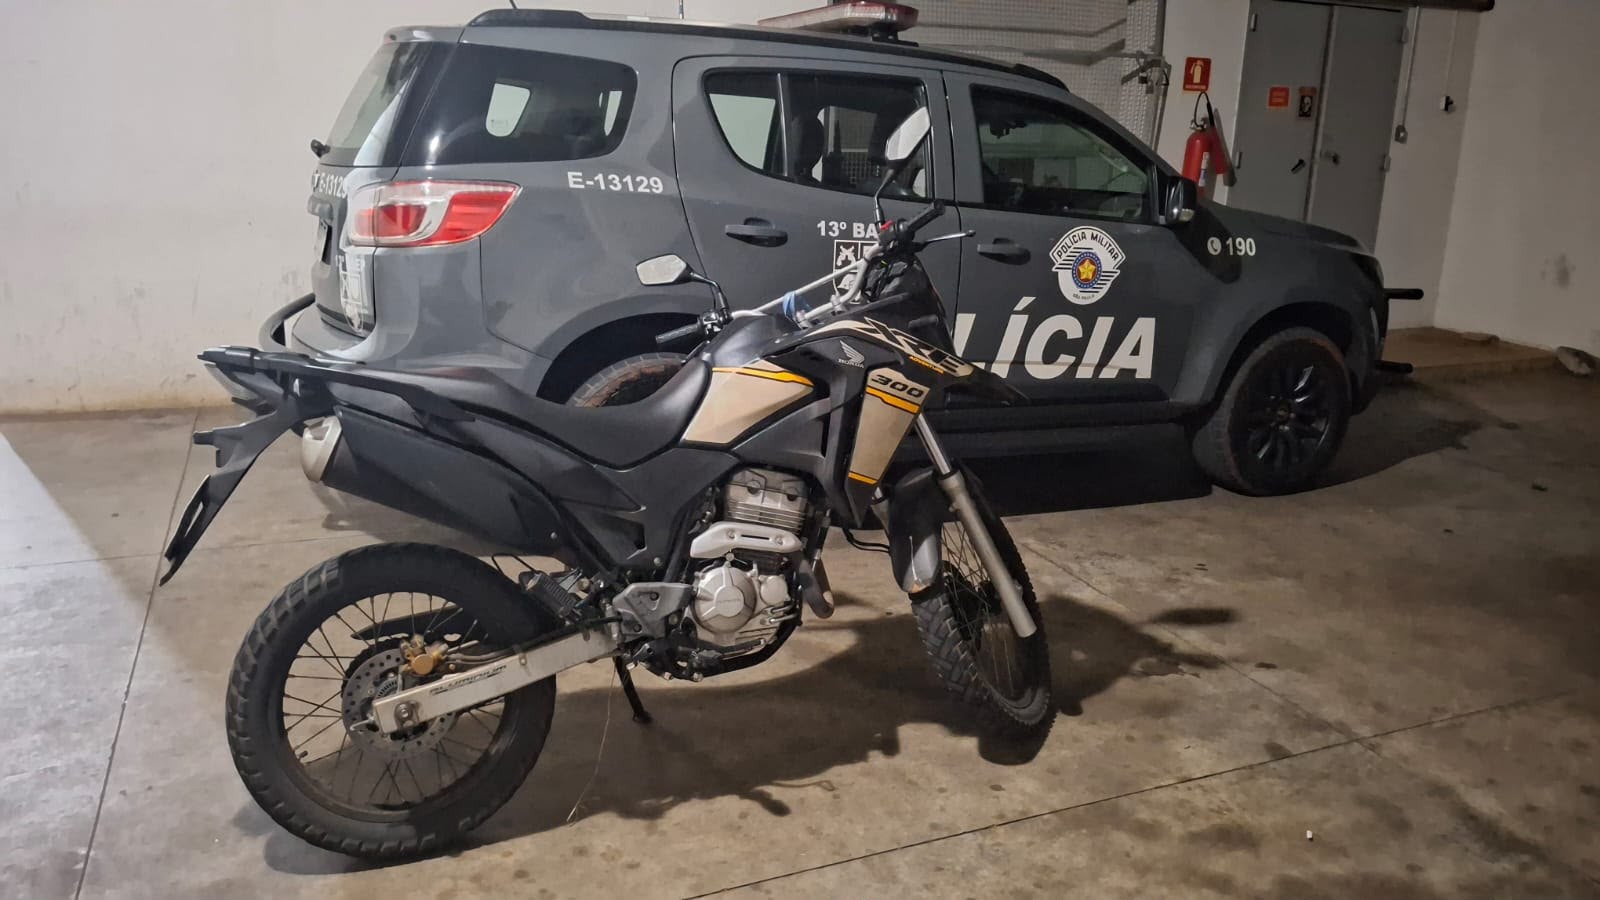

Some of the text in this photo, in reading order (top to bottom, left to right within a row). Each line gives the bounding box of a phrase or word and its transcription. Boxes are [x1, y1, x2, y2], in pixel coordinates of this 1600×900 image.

[567, 171, 664, 194] E-13129
[817, 220, 879, 239] 13º BA
[1056, 231, 1120, 261] POLÍCIA MILITAR
[1226, 236, 1257, 257] 190
[952, 296, 1156, 380] LÍCIA
[838, 358, 865, 369] HONDA
[871, 374, 924, 398] 300
